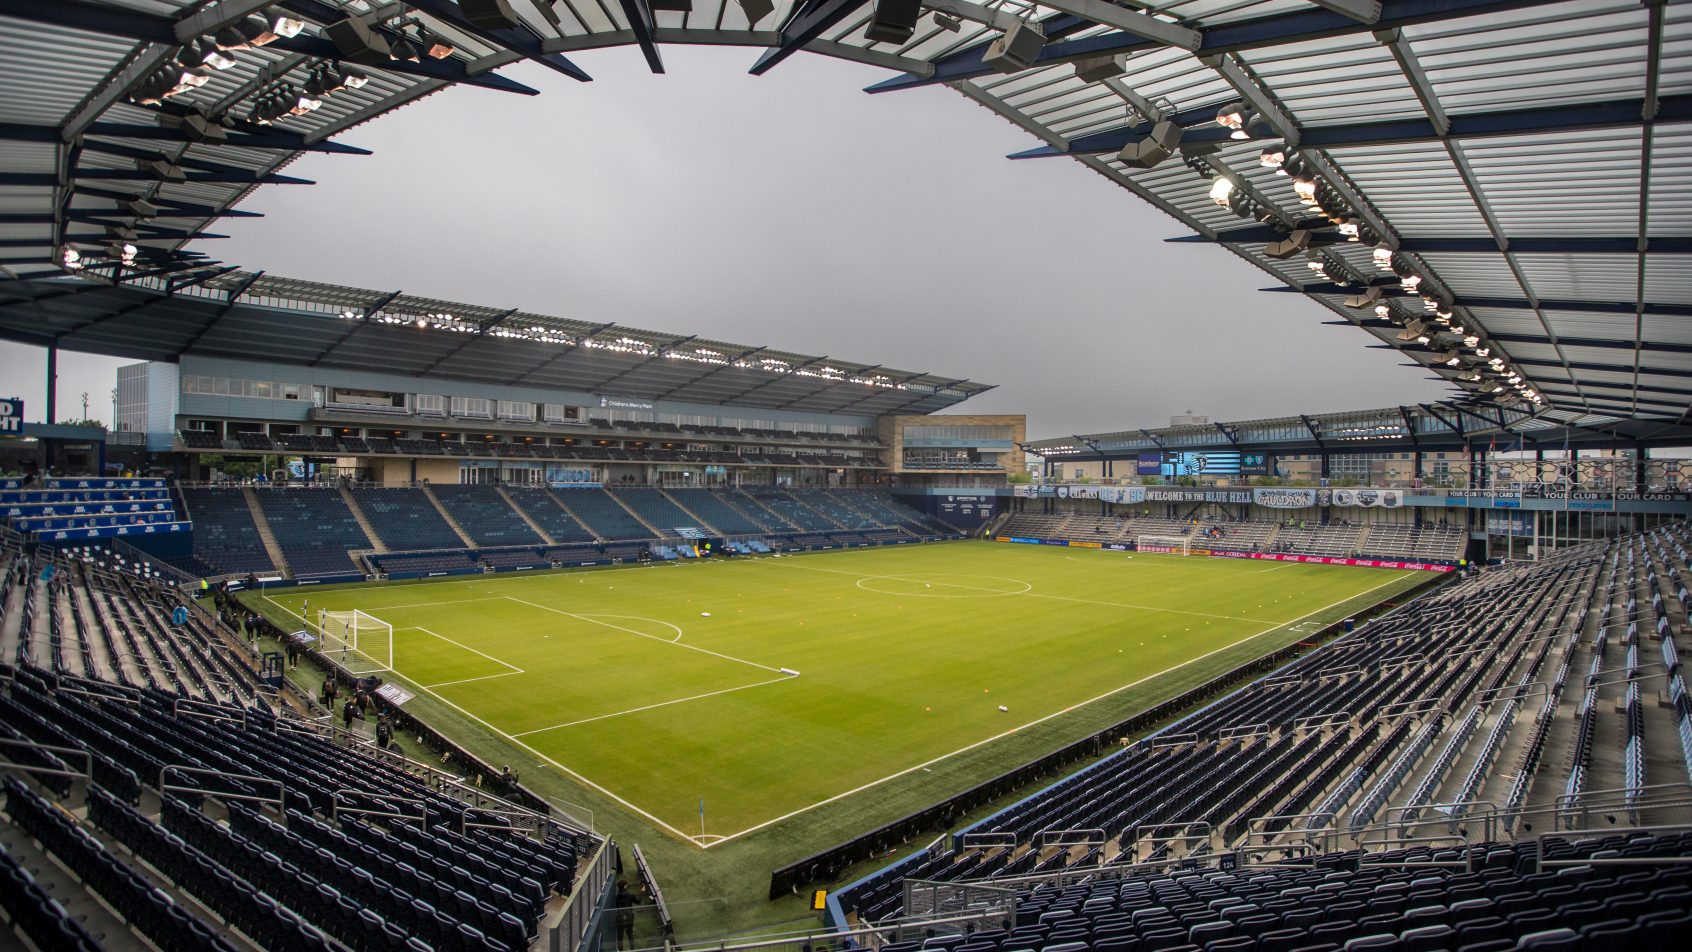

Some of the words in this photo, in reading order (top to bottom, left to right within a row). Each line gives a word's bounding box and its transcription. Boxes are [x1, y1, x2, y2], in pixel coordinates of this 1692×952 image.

[1147, 491, 1184, 501] WELCOME
[1206, 491, 1228, 502] BLUE
[1229, 492, 1252, 503] HELL
[1643, 493, 1671, 501] CARD
[1223, 861, 1234, 869] 124
